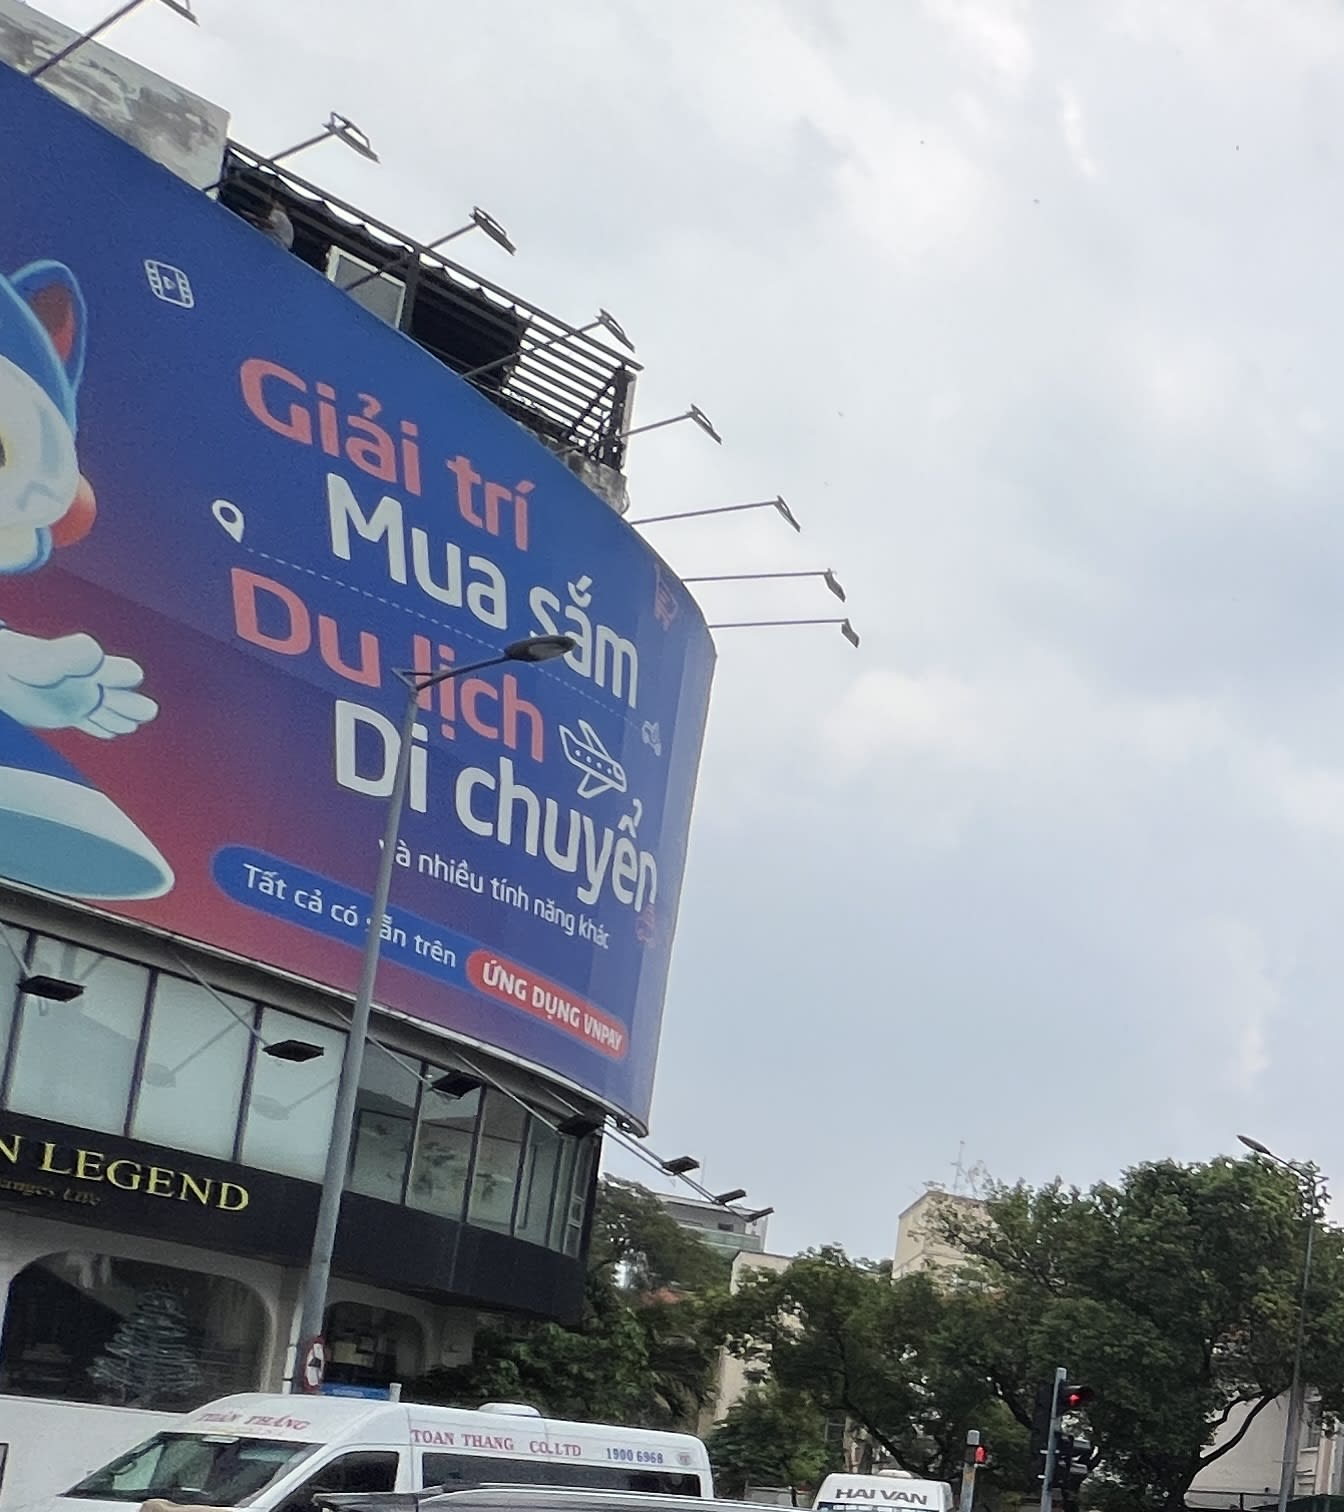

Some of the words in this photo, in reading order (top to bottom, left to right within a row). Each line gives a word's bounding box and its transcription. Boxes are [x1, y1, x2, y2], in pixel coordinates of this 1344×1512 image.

[240, 357, 421, 496] Giải
[447, 455, 531, 551] trí
[327, 472, 508, 630] Mua
[528, 575, 639, 708] sắm
[231, 568, 381, 689] Du
[413, 634, 545, 763] lịch
[335, 699, 429, 813] Di
[455, 756, 658, 912] chuyển
[243, 863, 288, 900] Tất
[294, 888, 323, 914] cả
[331, 905, 359, 927] có
[414, 935, 457, 968] trên
[418, 853, 484, 893] nhiều
[490, 876, 529, 911] tính
[534, 898, 575, 936] năng
[578, 914, 611, 949] khác
[482, 959, 528, 1001] ỨNG
[532, 985, 581, 1028] DỤNG
[583, 1012, 624, 1051] VNPAY
[38, 1142, 250, 1211] LEGEND
[411, 1429, 455, 1446] TOAN
[461, 1433, 515, 1451] THANG
[606, 1447, 634, 1462] 1900
